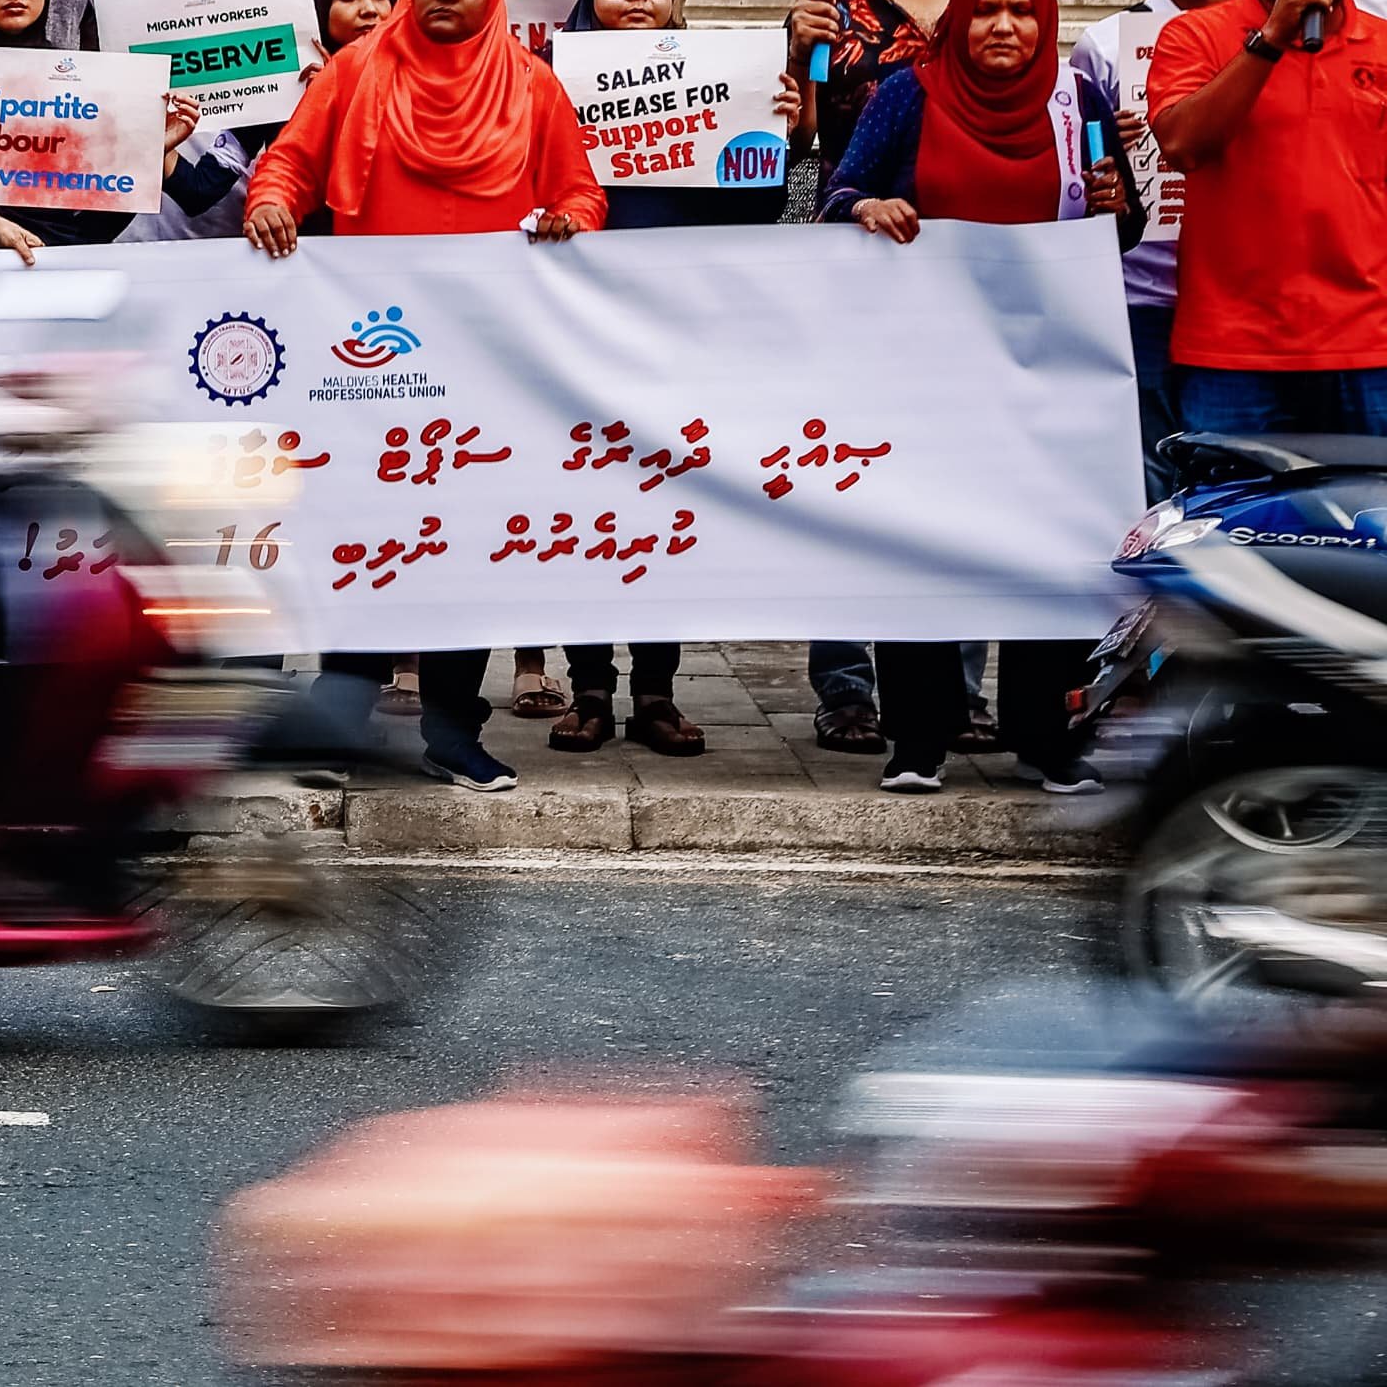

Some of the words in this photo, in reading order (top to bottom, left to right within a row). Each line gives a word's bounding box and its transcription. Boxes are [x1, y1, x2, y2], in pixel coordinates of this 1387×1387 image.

[146, 14, 204, 34] MIGRANT
[206, 5, 269, 25] WORKERS
[170, 37, 287, 77] ESERVE
[208, 90, 231, 101] AND
[233, 85, 266, 97] WORK
[267, 83, 279, 92] IN
[596, 61, 686, 92] SALARY
[201, 102, 244, 117] DIGNITY
[574, 91, 678, 125] NCREASE
[686, 82, 731, 108] FOR
[578, 108, 719, 151] Support
[610, 141, 696, 179] Staff
[723, 146, 782, 183] NOW
[308, 387, 405, 402] PROFESSIONALS
[409, 384, 446, 398] UNION
[323, 374, 379, 388] MALDIVES
[382, 372, 428, 386] HEALTH
[215, 522, 282, 571] 16
